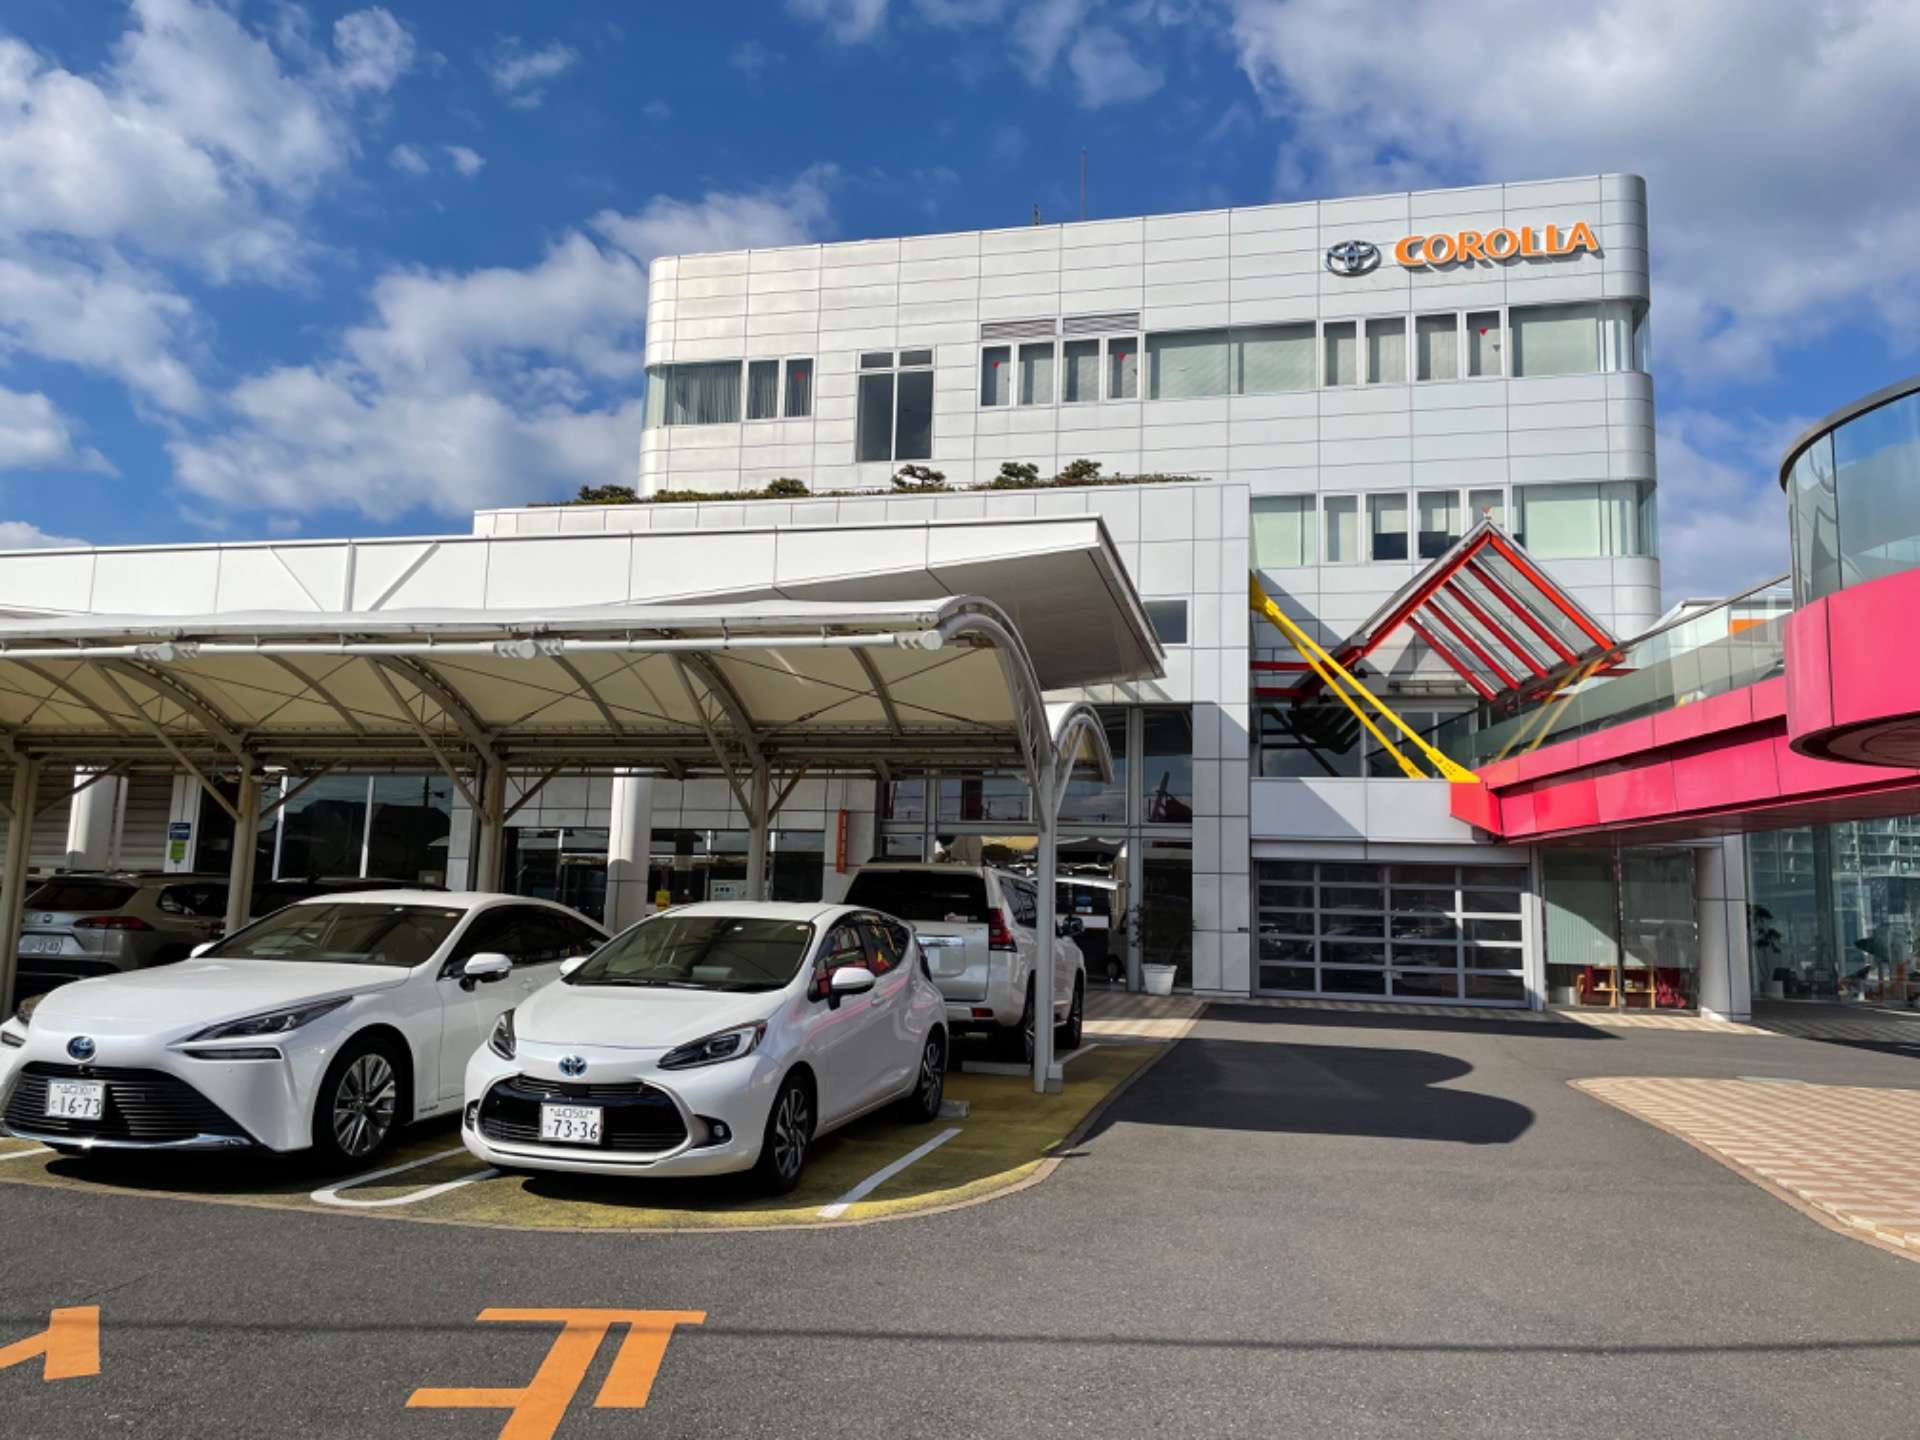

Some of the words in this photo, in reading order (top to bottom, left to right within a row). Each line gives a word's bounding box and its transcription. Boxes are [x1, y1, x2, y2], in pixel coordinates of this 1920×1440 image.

[1394, 221, 1599, 266] COROLLA
[60, 1096, 100, 1115] 16-73
[553, 1119, 598, 1139] 73-36
